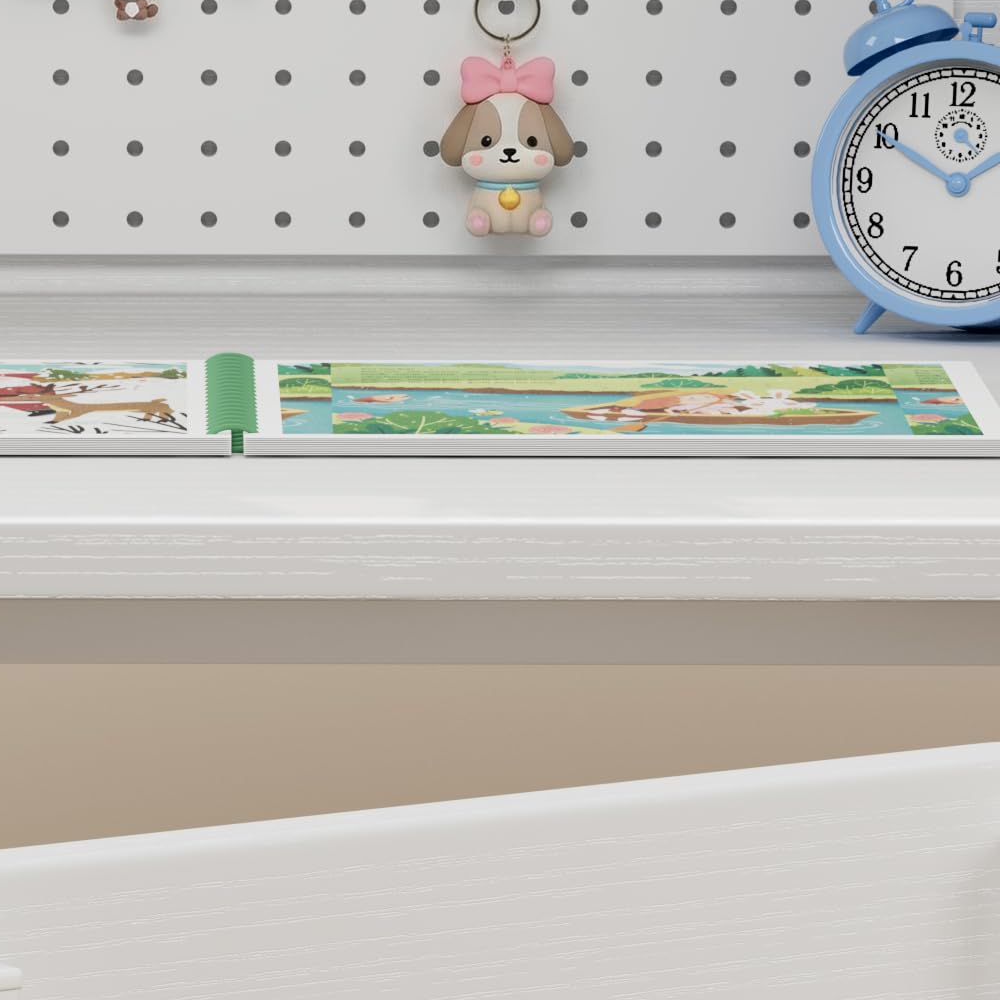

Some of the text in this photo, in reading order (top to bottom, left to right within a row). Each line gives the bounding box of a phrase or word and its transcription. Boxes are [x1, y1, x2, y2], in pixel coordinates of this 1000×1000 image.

[909, 92, 931, 118] 11
[949, 81, 976, 107] 12
[874, 122, 899, 149] 10
[857, 167, 873, 193] 9
[867, 212, 884, 239] 8
[902, 246, 919, 272] 7
[946, 260, 963, 287] 6
